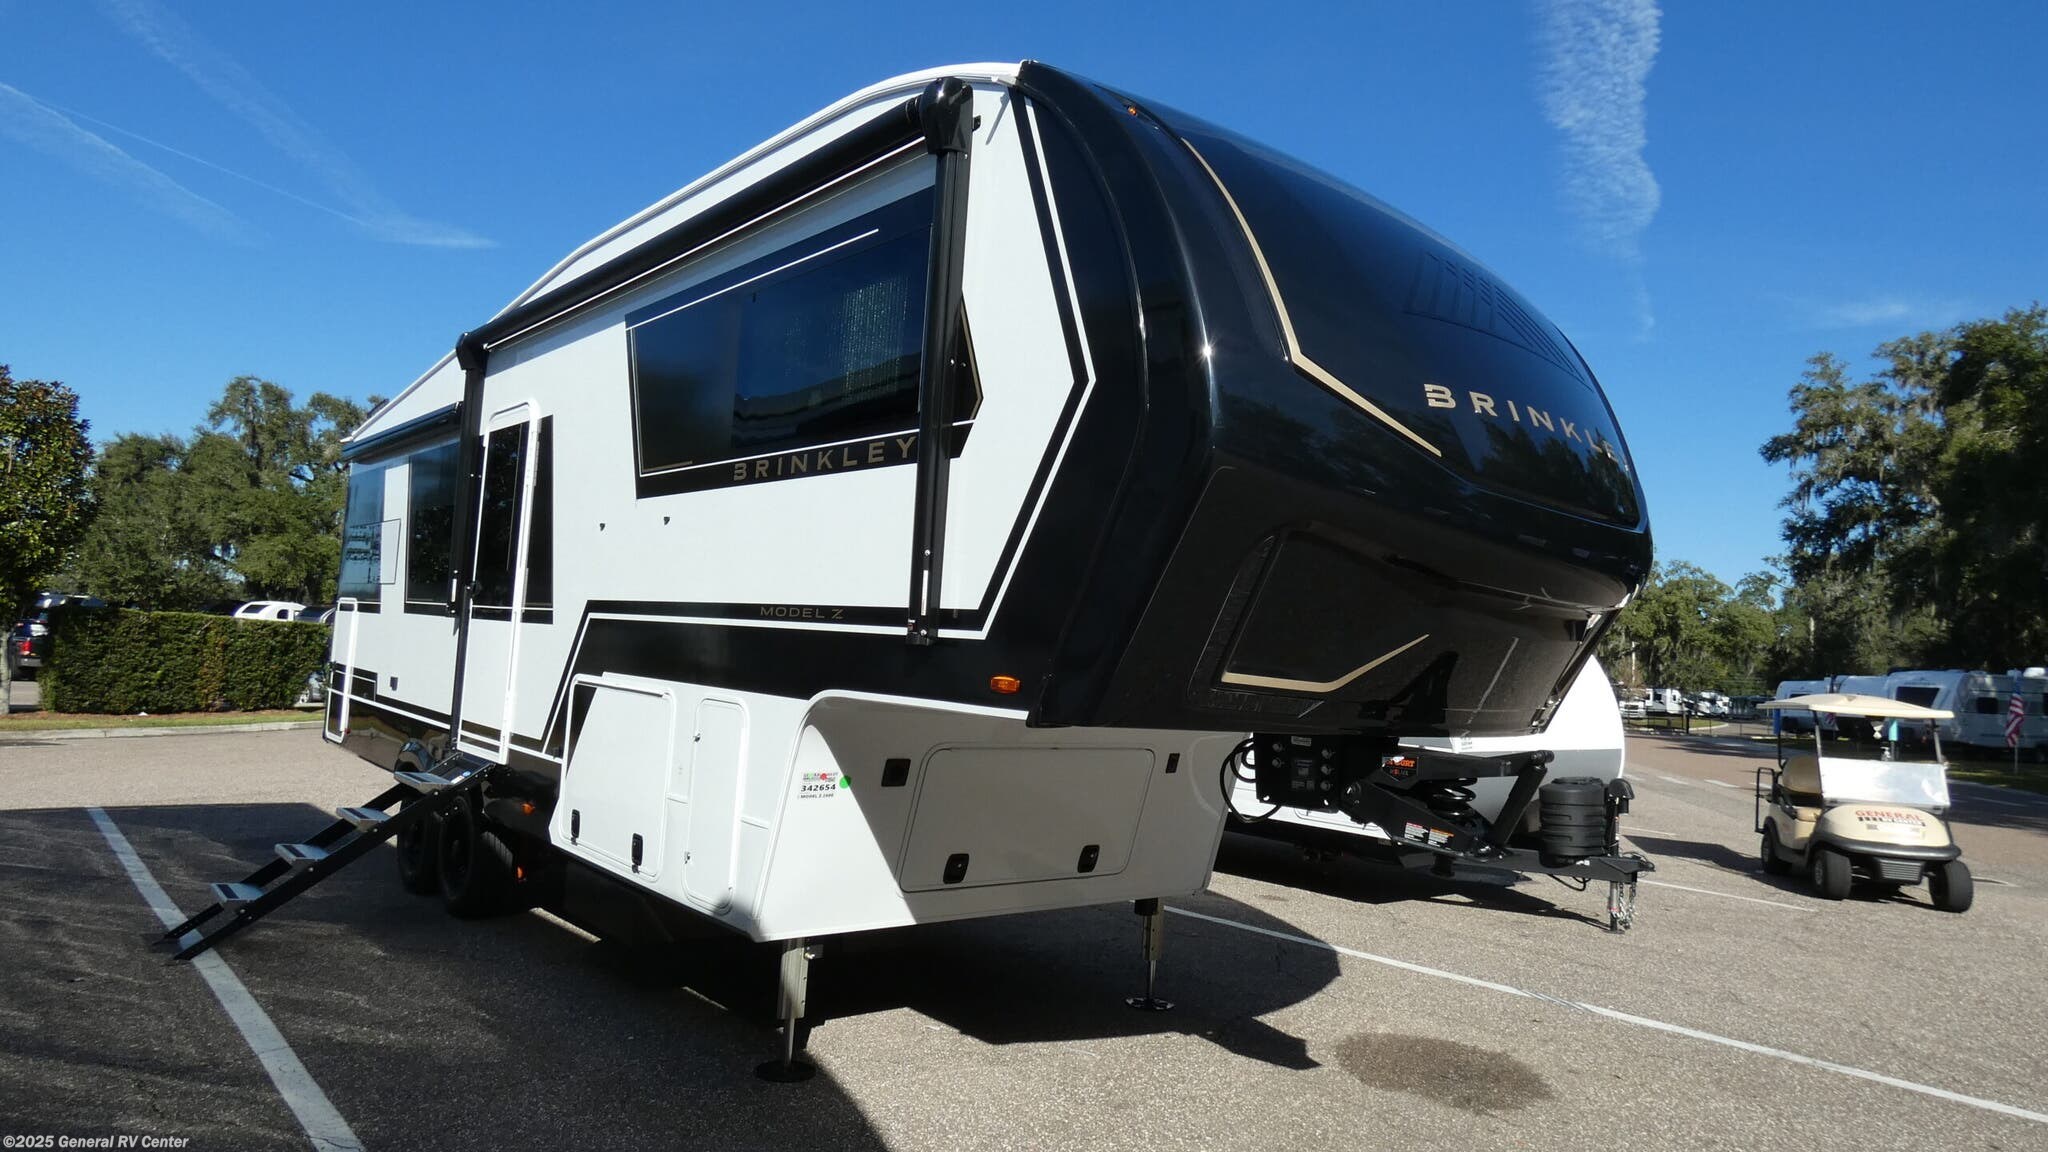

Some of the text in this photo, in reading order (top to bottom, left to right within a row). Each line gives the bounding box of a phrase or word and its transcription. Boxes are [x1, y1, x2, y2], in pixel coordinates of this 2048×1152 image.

[1424, 383, 1629, 472] BRINKLE
[733, 436, 917, 481] BRINKLEY
[760, 606, 845, 620] MODEL Z
[801, 784, 836, 792] 342654
[1855, 810, 1922, 822] GENERAL
